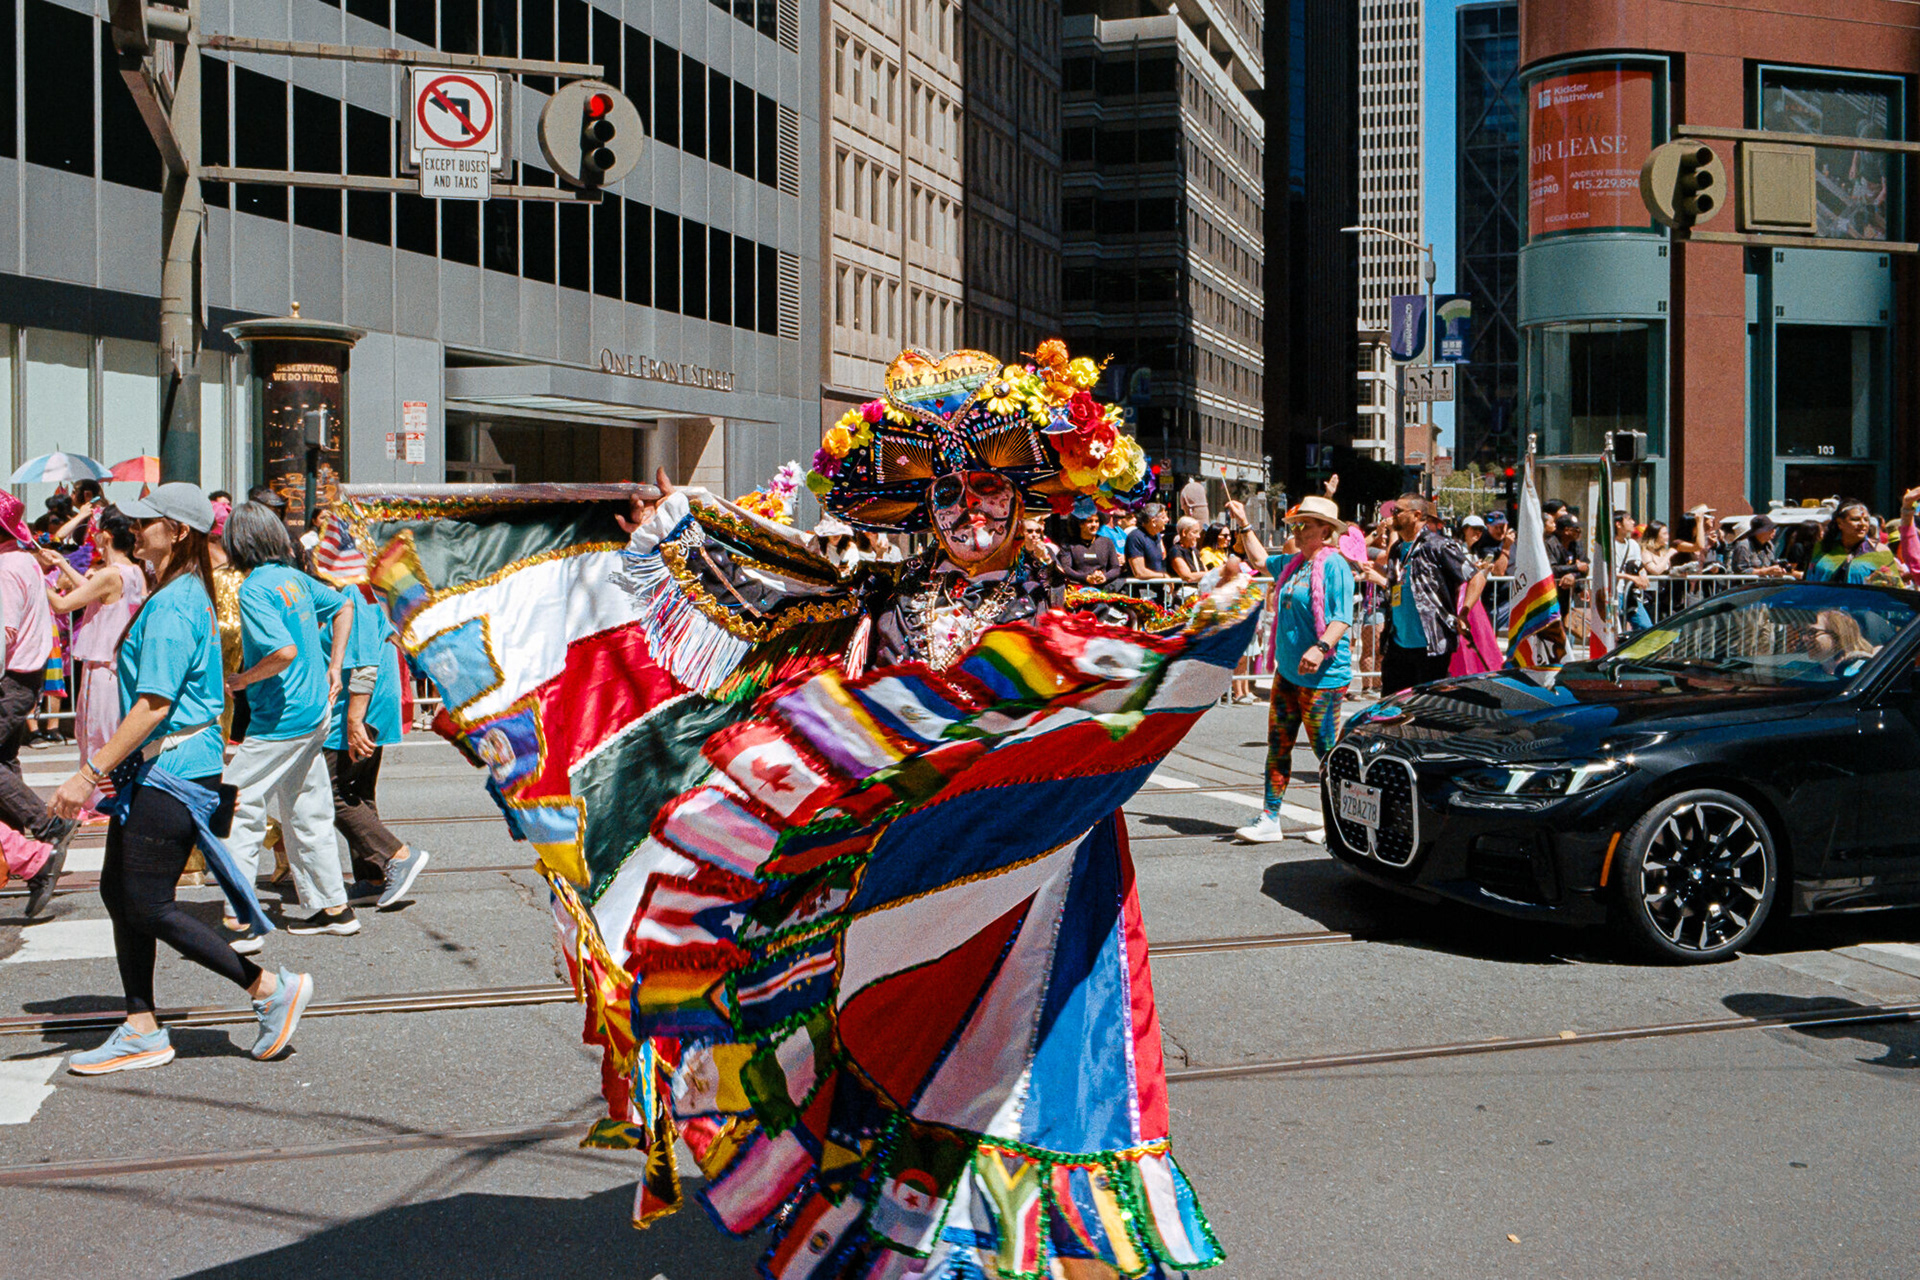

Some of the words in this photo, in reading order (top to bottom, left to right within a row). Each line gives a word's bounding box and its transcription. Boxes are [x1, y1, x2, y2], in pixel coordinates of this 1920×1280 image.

[1554, 84, 1588, 95] Kidder
[1554, 92, 1604, 105] Mathews
[1530, 143, 1552, 167] OR
[1558, 135, 1628, 159] LEASE
[425, 158, 455, 171] EXCEPT
[459, 159, 486, 173] BUSES
[434, 174, 451, 188] AND
[455, 176, 478, 189] TAXIS
[1572, 178, 1640, 190] 415.229.894
[600, 347, 634, 376] ONE
[639, 354, 687, 384] FRONT
[690, 363, 735, 391] STREET
[272, 372, 287, 382] WE
[287, 373, 300, 382] DO
[301, 373, 324, 384] THAT,
[893, 373, 924, 391] BAY
[932, 364, 990, 383] TIMES
[1817, 445, 1835, 455] 103
[1342, 795, 1377, 823] 9ZBA278
